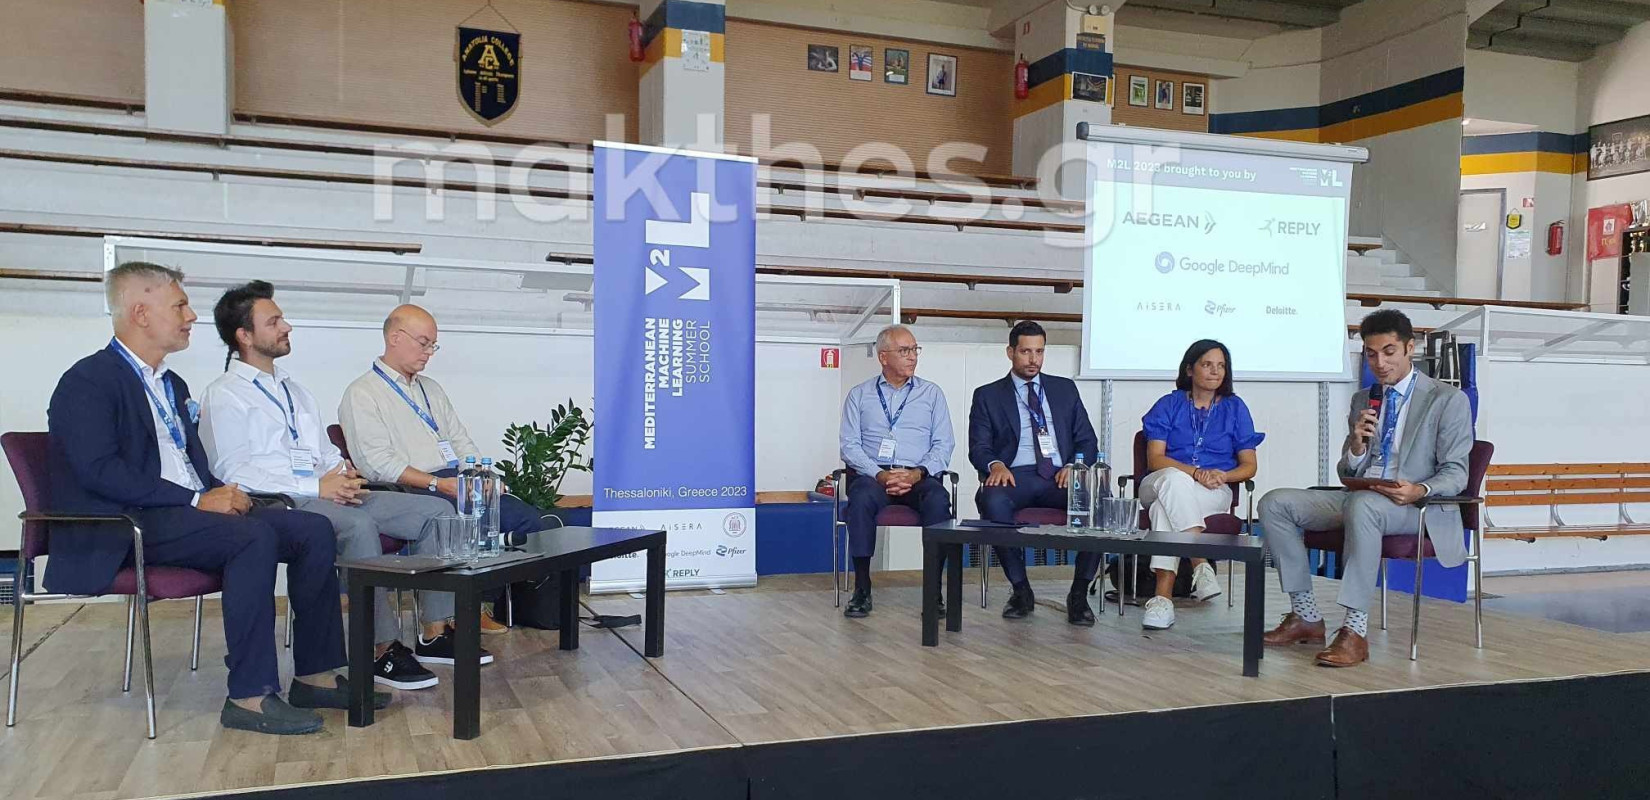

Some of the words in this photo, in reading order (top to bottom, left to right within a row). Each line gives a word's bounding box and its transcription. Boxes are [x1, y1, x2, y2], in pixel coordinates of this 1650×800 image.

[1106, 158, 1131, 170] M2L
[1133, 160, 1161, 172] 2023
[1163, 163, 1206, 177] brought
[1208, 168, 1220, 177] to
[1222, 170, 1241, 180] you
[1243, 169, 1257, 182] by
[1122, 211, 1200, 229] AEGEAN
[1277, 221, 1321, 236] REPLY
[1179, 256, 1225, 275] Google
[1228, 260, 1290, 277] DeepMind
[658, 318, 669, 389] MACHINE
[672, 319, 683, 397] LEARNING
[686, 320, 697, 383] SUMMER
[699, 320, 711, 383] SCHOOL
[644, 317, 656, 449] MEDITERRANEAN
[604, 487, 675, 499] Thessaloniki,
[678, 486, 718, 498] Greece
[720, 486, 747, 497] 2023
[680, 549, 711, 557] DeepMind
[727, 546, 747, 558] Pfizer
[673, 568, 700, 577] REPLY
